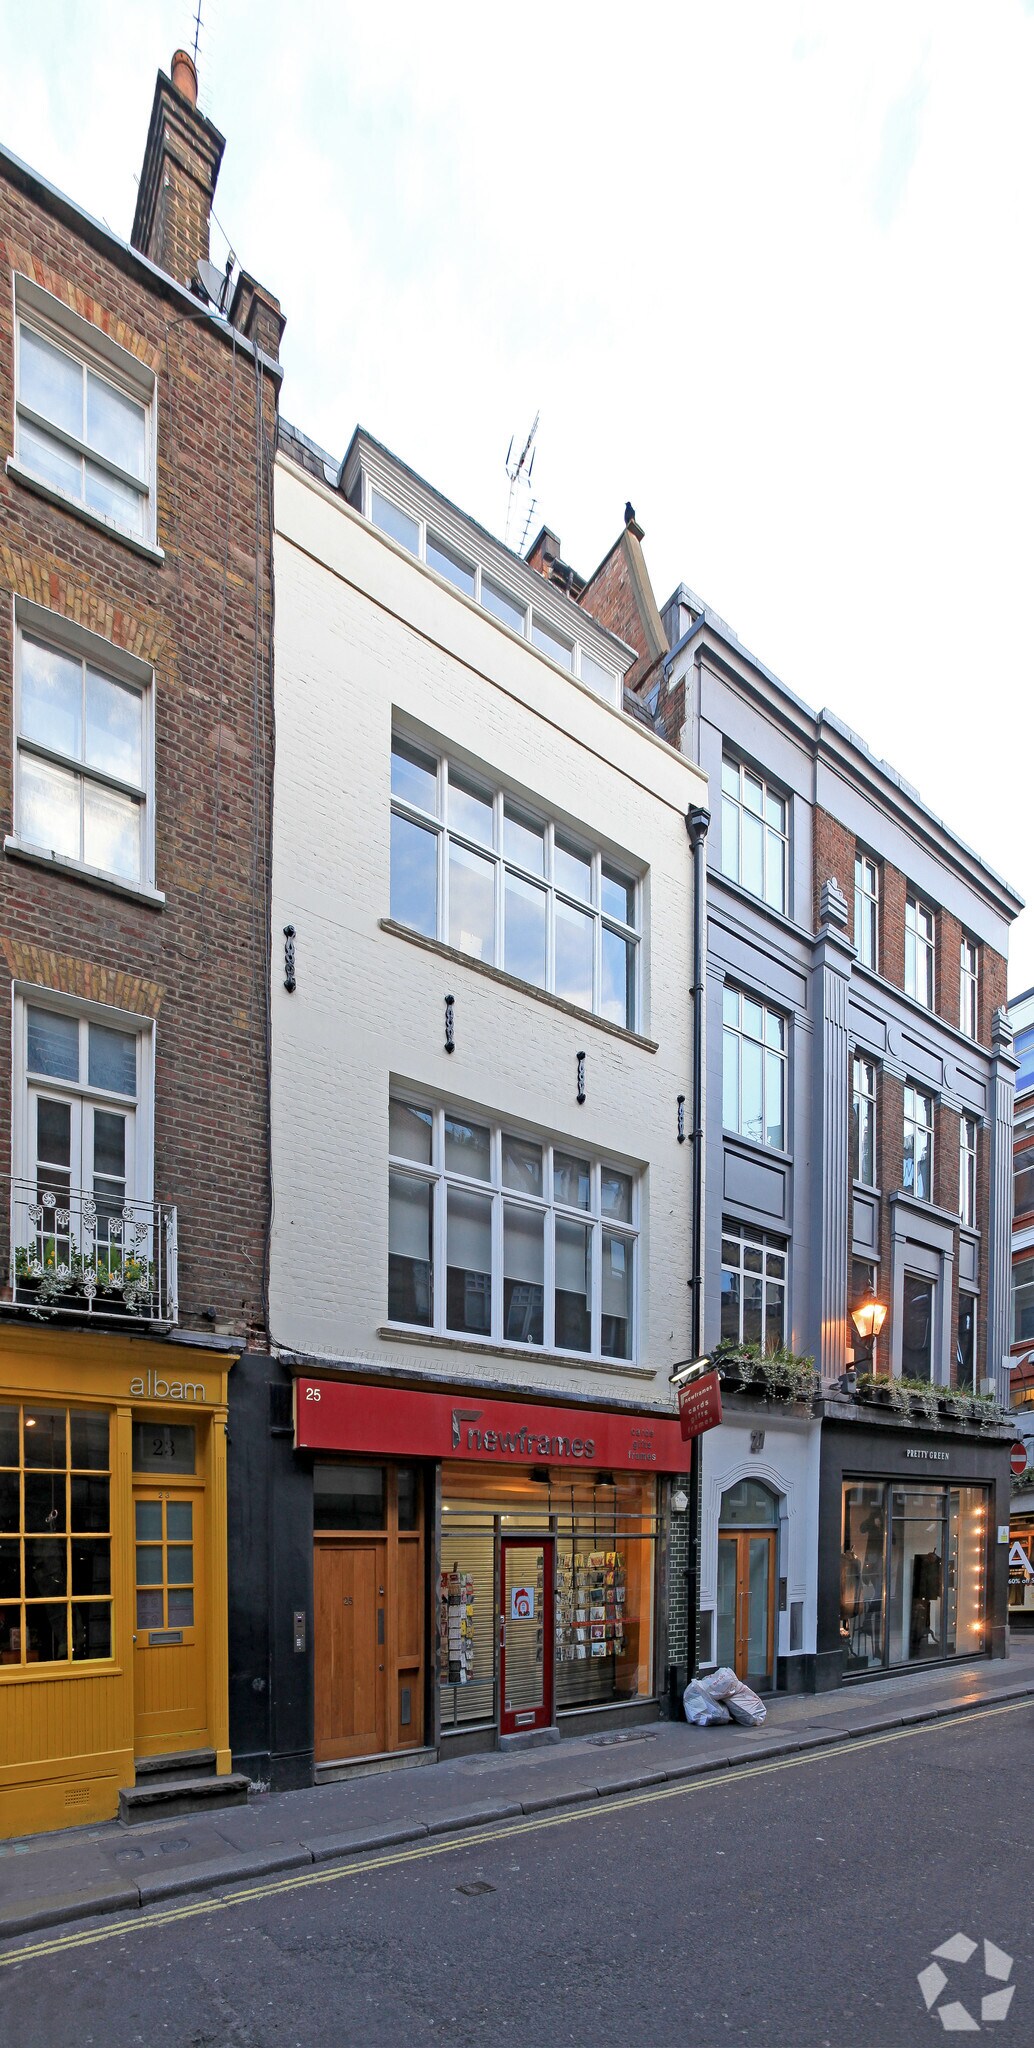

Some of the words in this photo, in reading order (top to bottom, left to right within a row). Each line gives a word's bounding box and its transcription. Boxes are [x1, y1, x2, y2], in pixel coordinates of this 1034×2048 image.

[130, 1369, 205, 1400] albam
[306, 1387, 321, 1401] 25
[684, 1385, 713, 1403] newframes
[688, 1399, 709, 1415] cards
[153, 1439, 175, 1457] 23
[906, 1449, 928, 1459] PRETTY
[929, 1451, 950, 1460] GREEN
